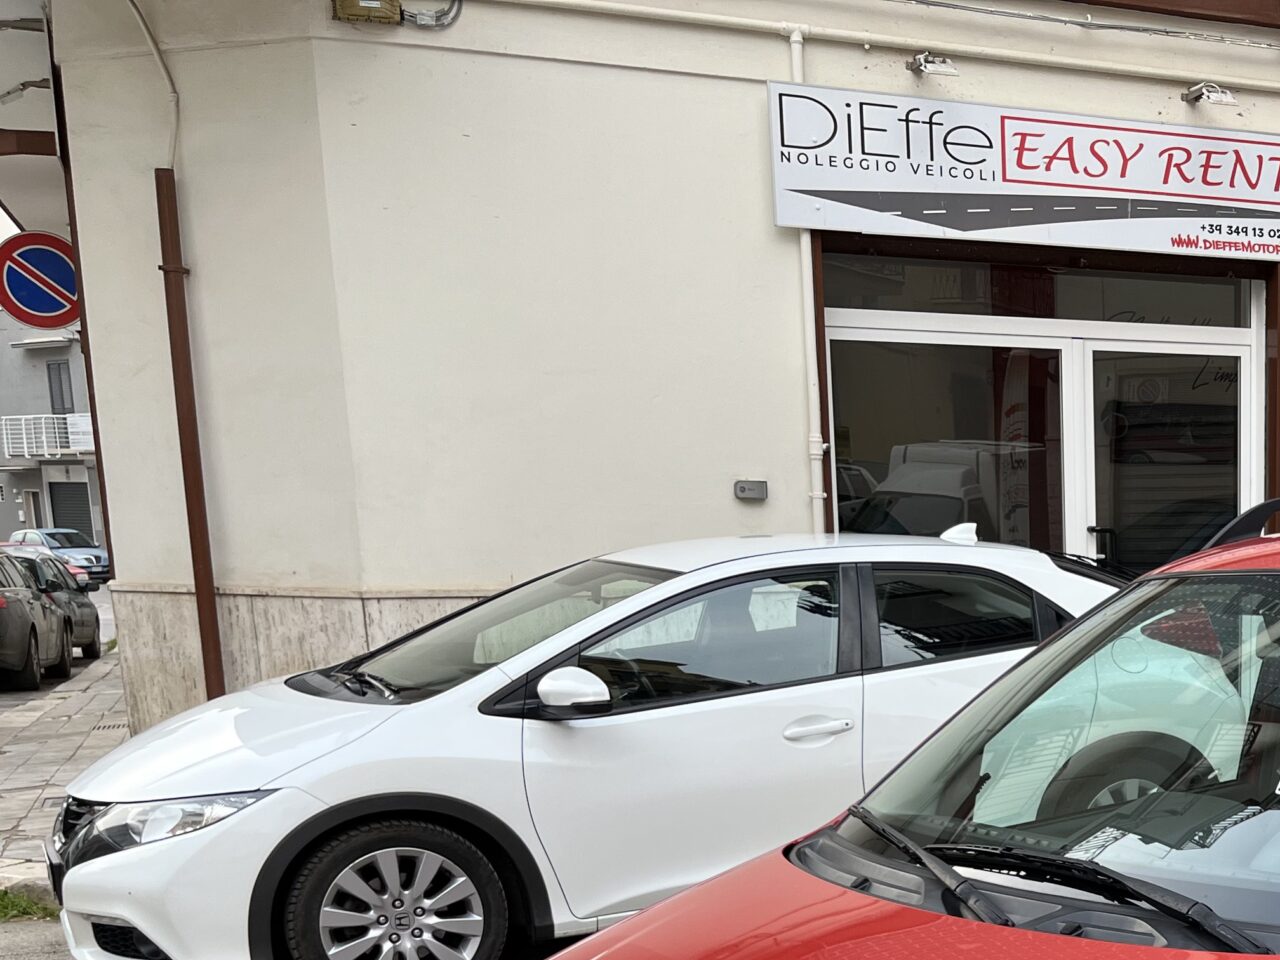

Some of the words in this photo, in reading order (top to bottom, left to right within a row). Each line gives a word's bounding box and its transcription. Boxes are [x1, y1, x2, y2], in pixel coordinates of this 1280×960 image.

[778, 92, 994, 162] DiEffe
[780, 151, 897, 173] NOLEGGIO
[910, 162, 997, 182] VEICOLI
[1011, 132, 1145, 179] EASY
[1200, 223, 1222, 235] +39
[1226, 225, 1248, 236] 349
[1252, 227, 1264, 238] 13
